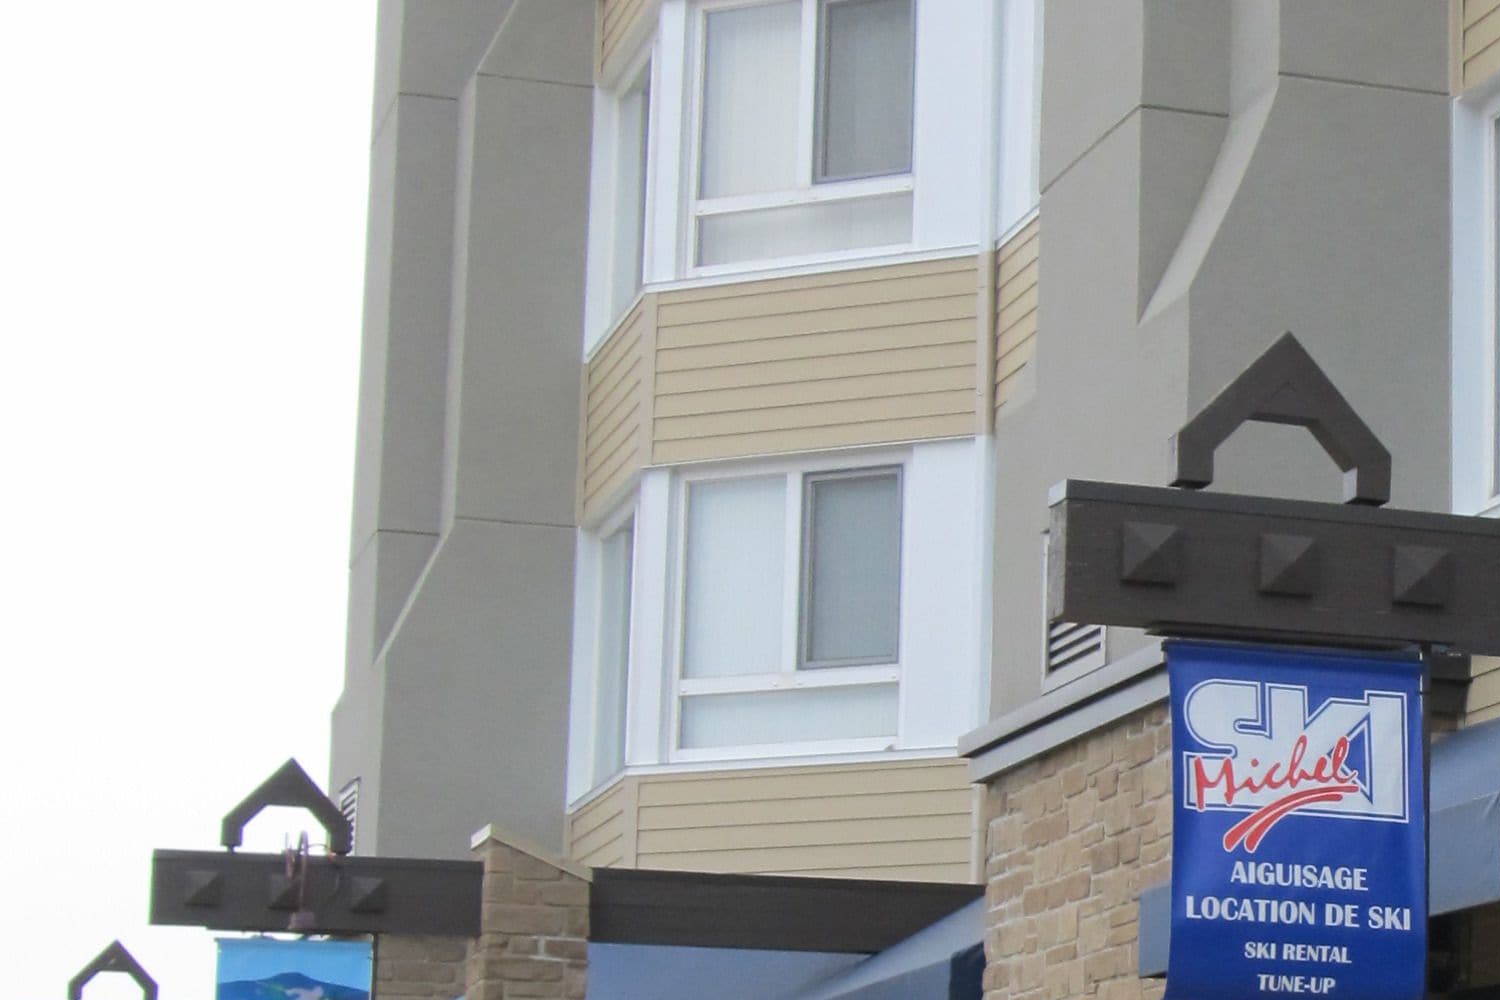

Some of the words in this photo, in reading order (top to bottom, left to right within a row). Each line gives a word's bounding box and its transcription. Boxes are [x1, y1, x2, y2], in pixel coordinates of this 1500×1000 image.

[1183, 678, 1410, 823] SKI
[1194, 734, 1359, 812] Michel
[1230, 861, 1369, 892] AIGUISAGE
[1186, 895, 1316, 925] LOCATION
[1325, 904, 1360, 928] DE
[1368, 906, 1412, 931] SKI
[1244, 941, 1276, 960] SKI
[1283, 943, 1352, 965] RENTAL
[1258, 973, 1336, 995] TUNE-UP
